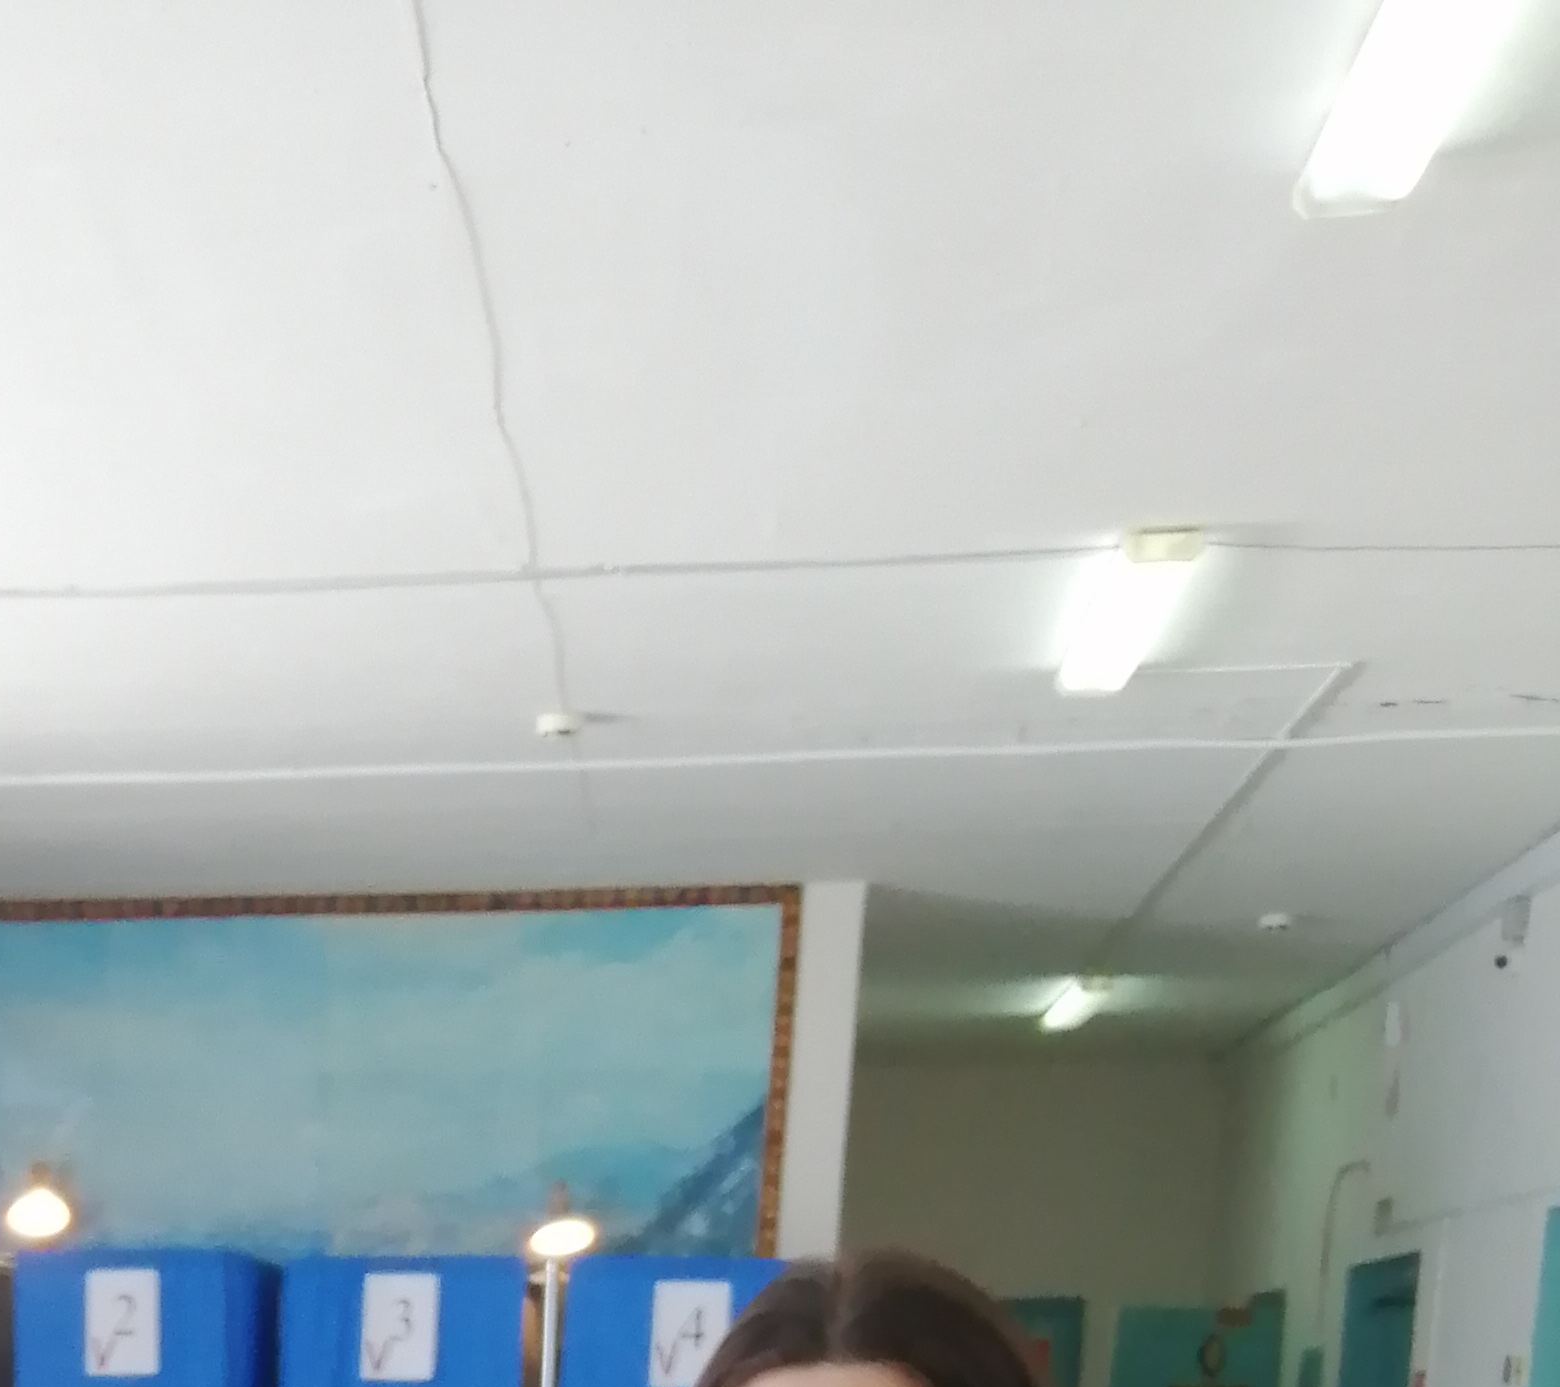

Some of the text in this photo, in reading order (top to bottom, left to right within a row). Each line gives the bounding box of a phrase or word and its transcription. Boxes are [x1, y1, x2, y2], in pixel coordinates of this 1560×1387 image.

[114, 1293, 138, 1337] 2
[391, 1298, 416, 1342] 3
[679, 1307, 705, 1349] 4
